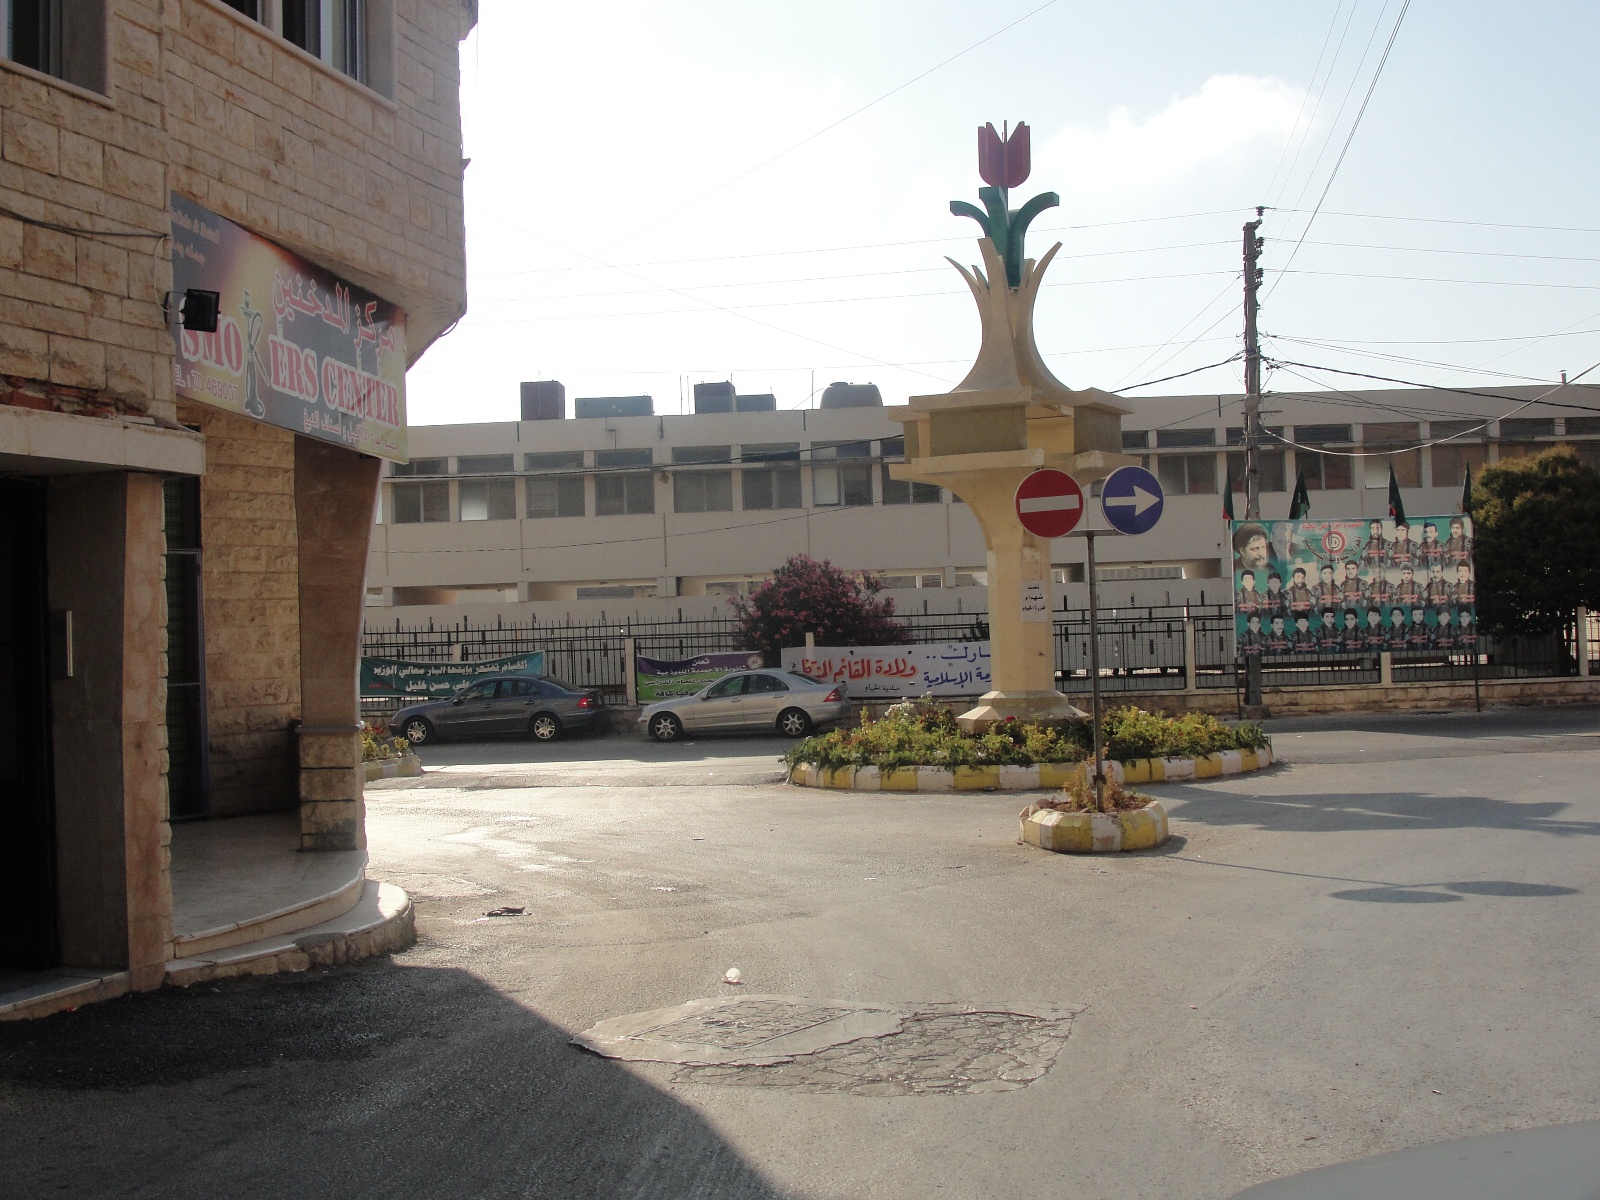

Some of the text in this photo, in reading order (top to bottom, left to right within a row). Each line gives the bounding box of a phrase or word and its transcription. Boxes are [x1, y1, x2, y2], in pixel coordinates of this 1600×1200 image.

[272, 269, 395, 358] مركز المدخنين
[322, 356, 400, 428] CENTER
[373, 664, 397, 676] الوزير
[501, 659, 528, 674] الخيام
[833, 657, 871, 683] القائم
[875, 658, 917, 677] ولادة
[405, 680, 427, 692] خليل
[429, 681, 450, 692] حسن
[923, 670, 973, 689] الإسلامية
